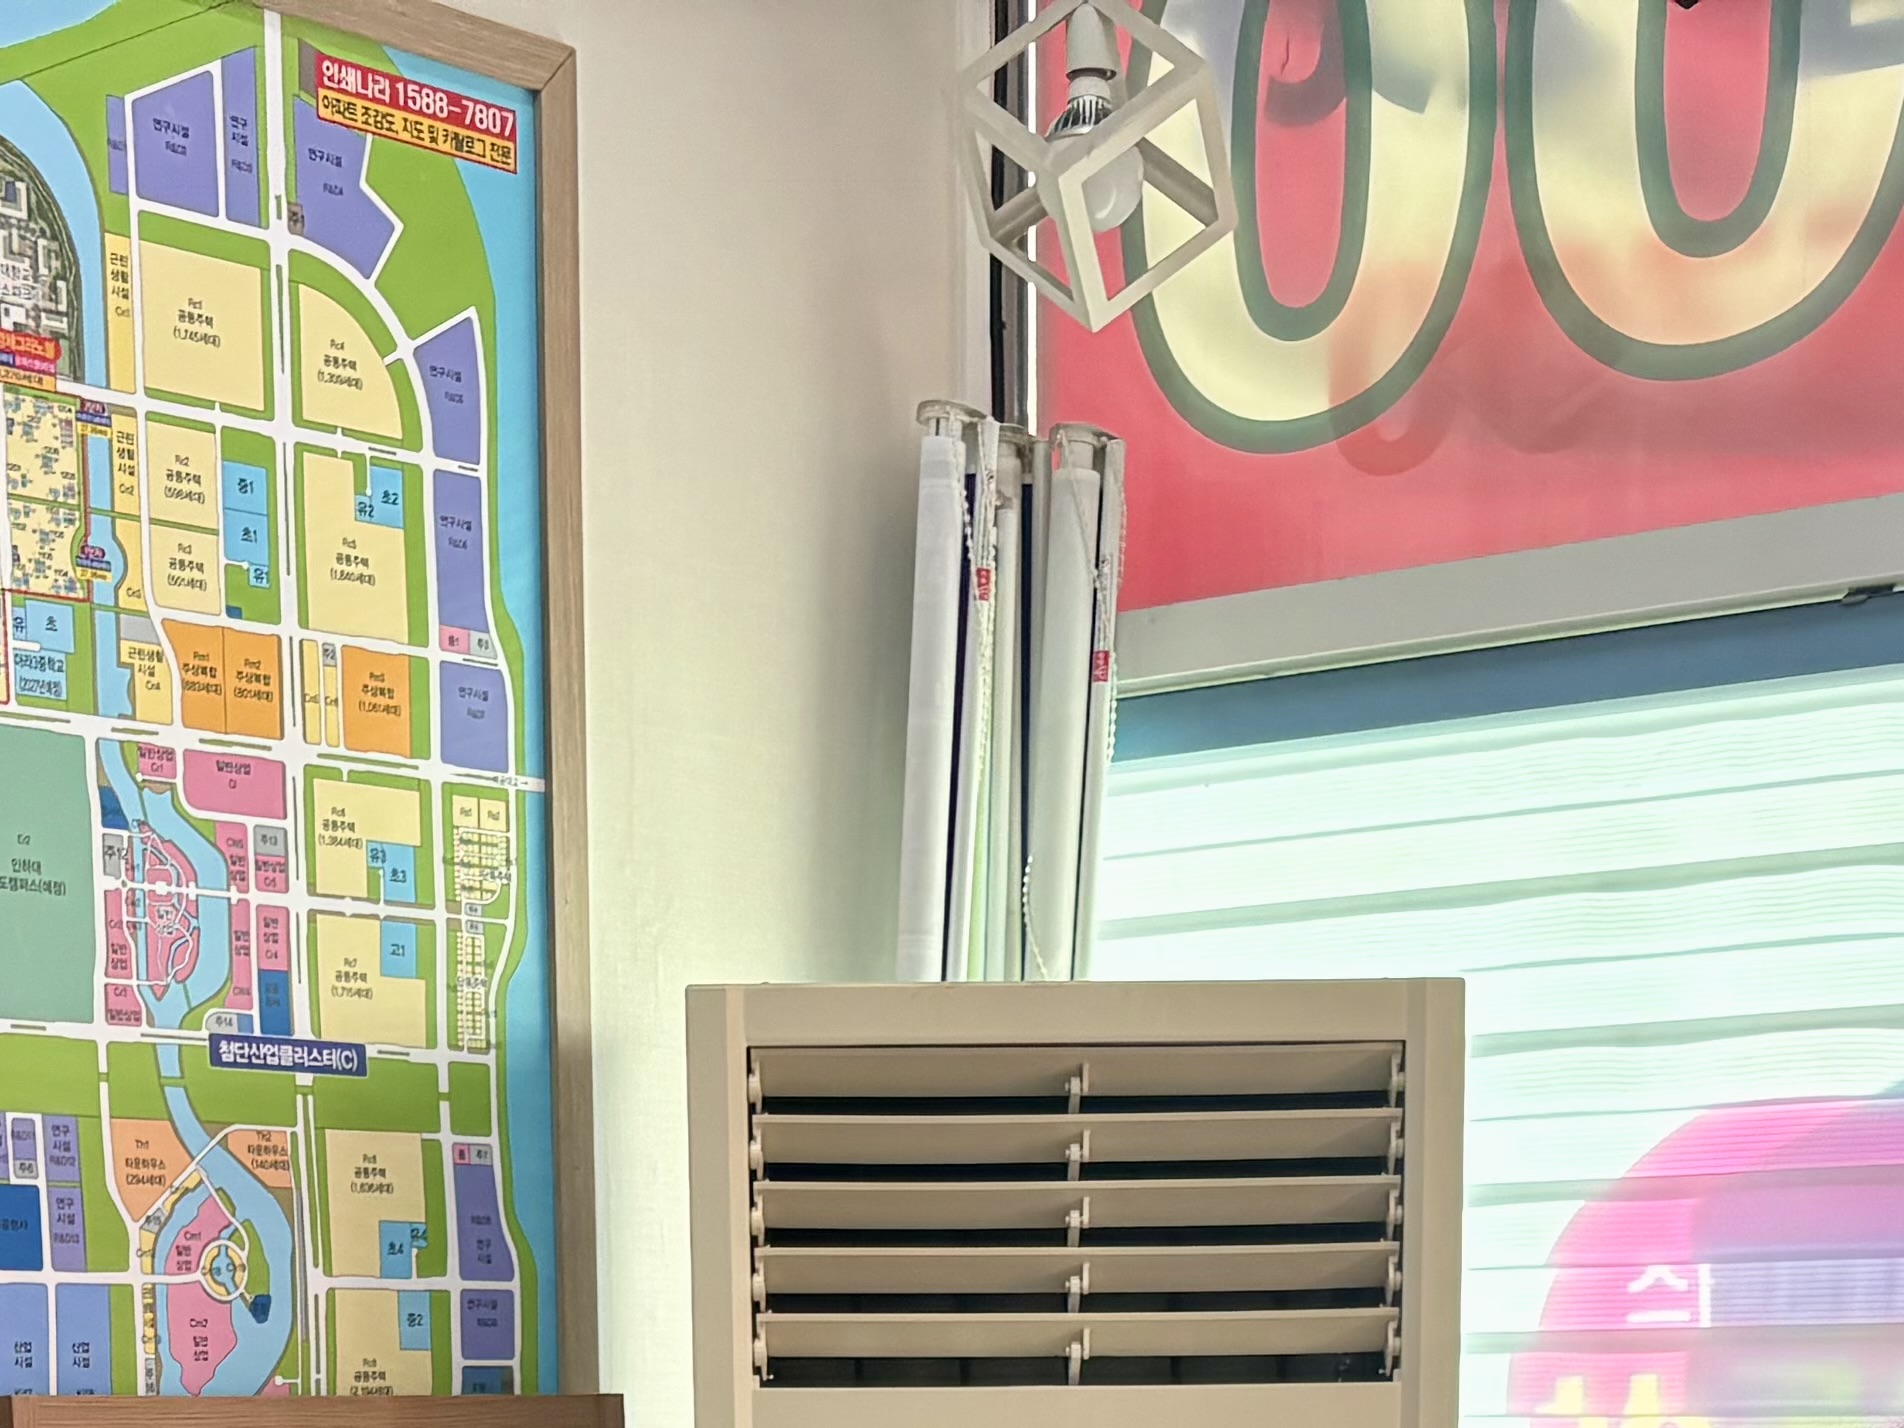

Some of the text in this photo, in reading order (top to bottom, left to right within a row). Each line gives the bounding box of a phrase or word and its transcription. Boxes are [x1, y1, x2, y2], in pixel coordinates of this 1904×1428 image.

[322, 61, 515, 137] 인쇄나라 1588-7807
[322, 95, 358, 122] 아파트
[361, 104, 399, 135] 조감도,
[402, 115, 426, 137] 지도
[490, 141, 514, 165] 전문
[177, 311, 214, 329] 공동주택
[323, 353, 357, 371] 공동주택
[11, 858, 42, 874] 인하대
[218, 1040, 359, 1072] 첨단산업클러스터(C)
